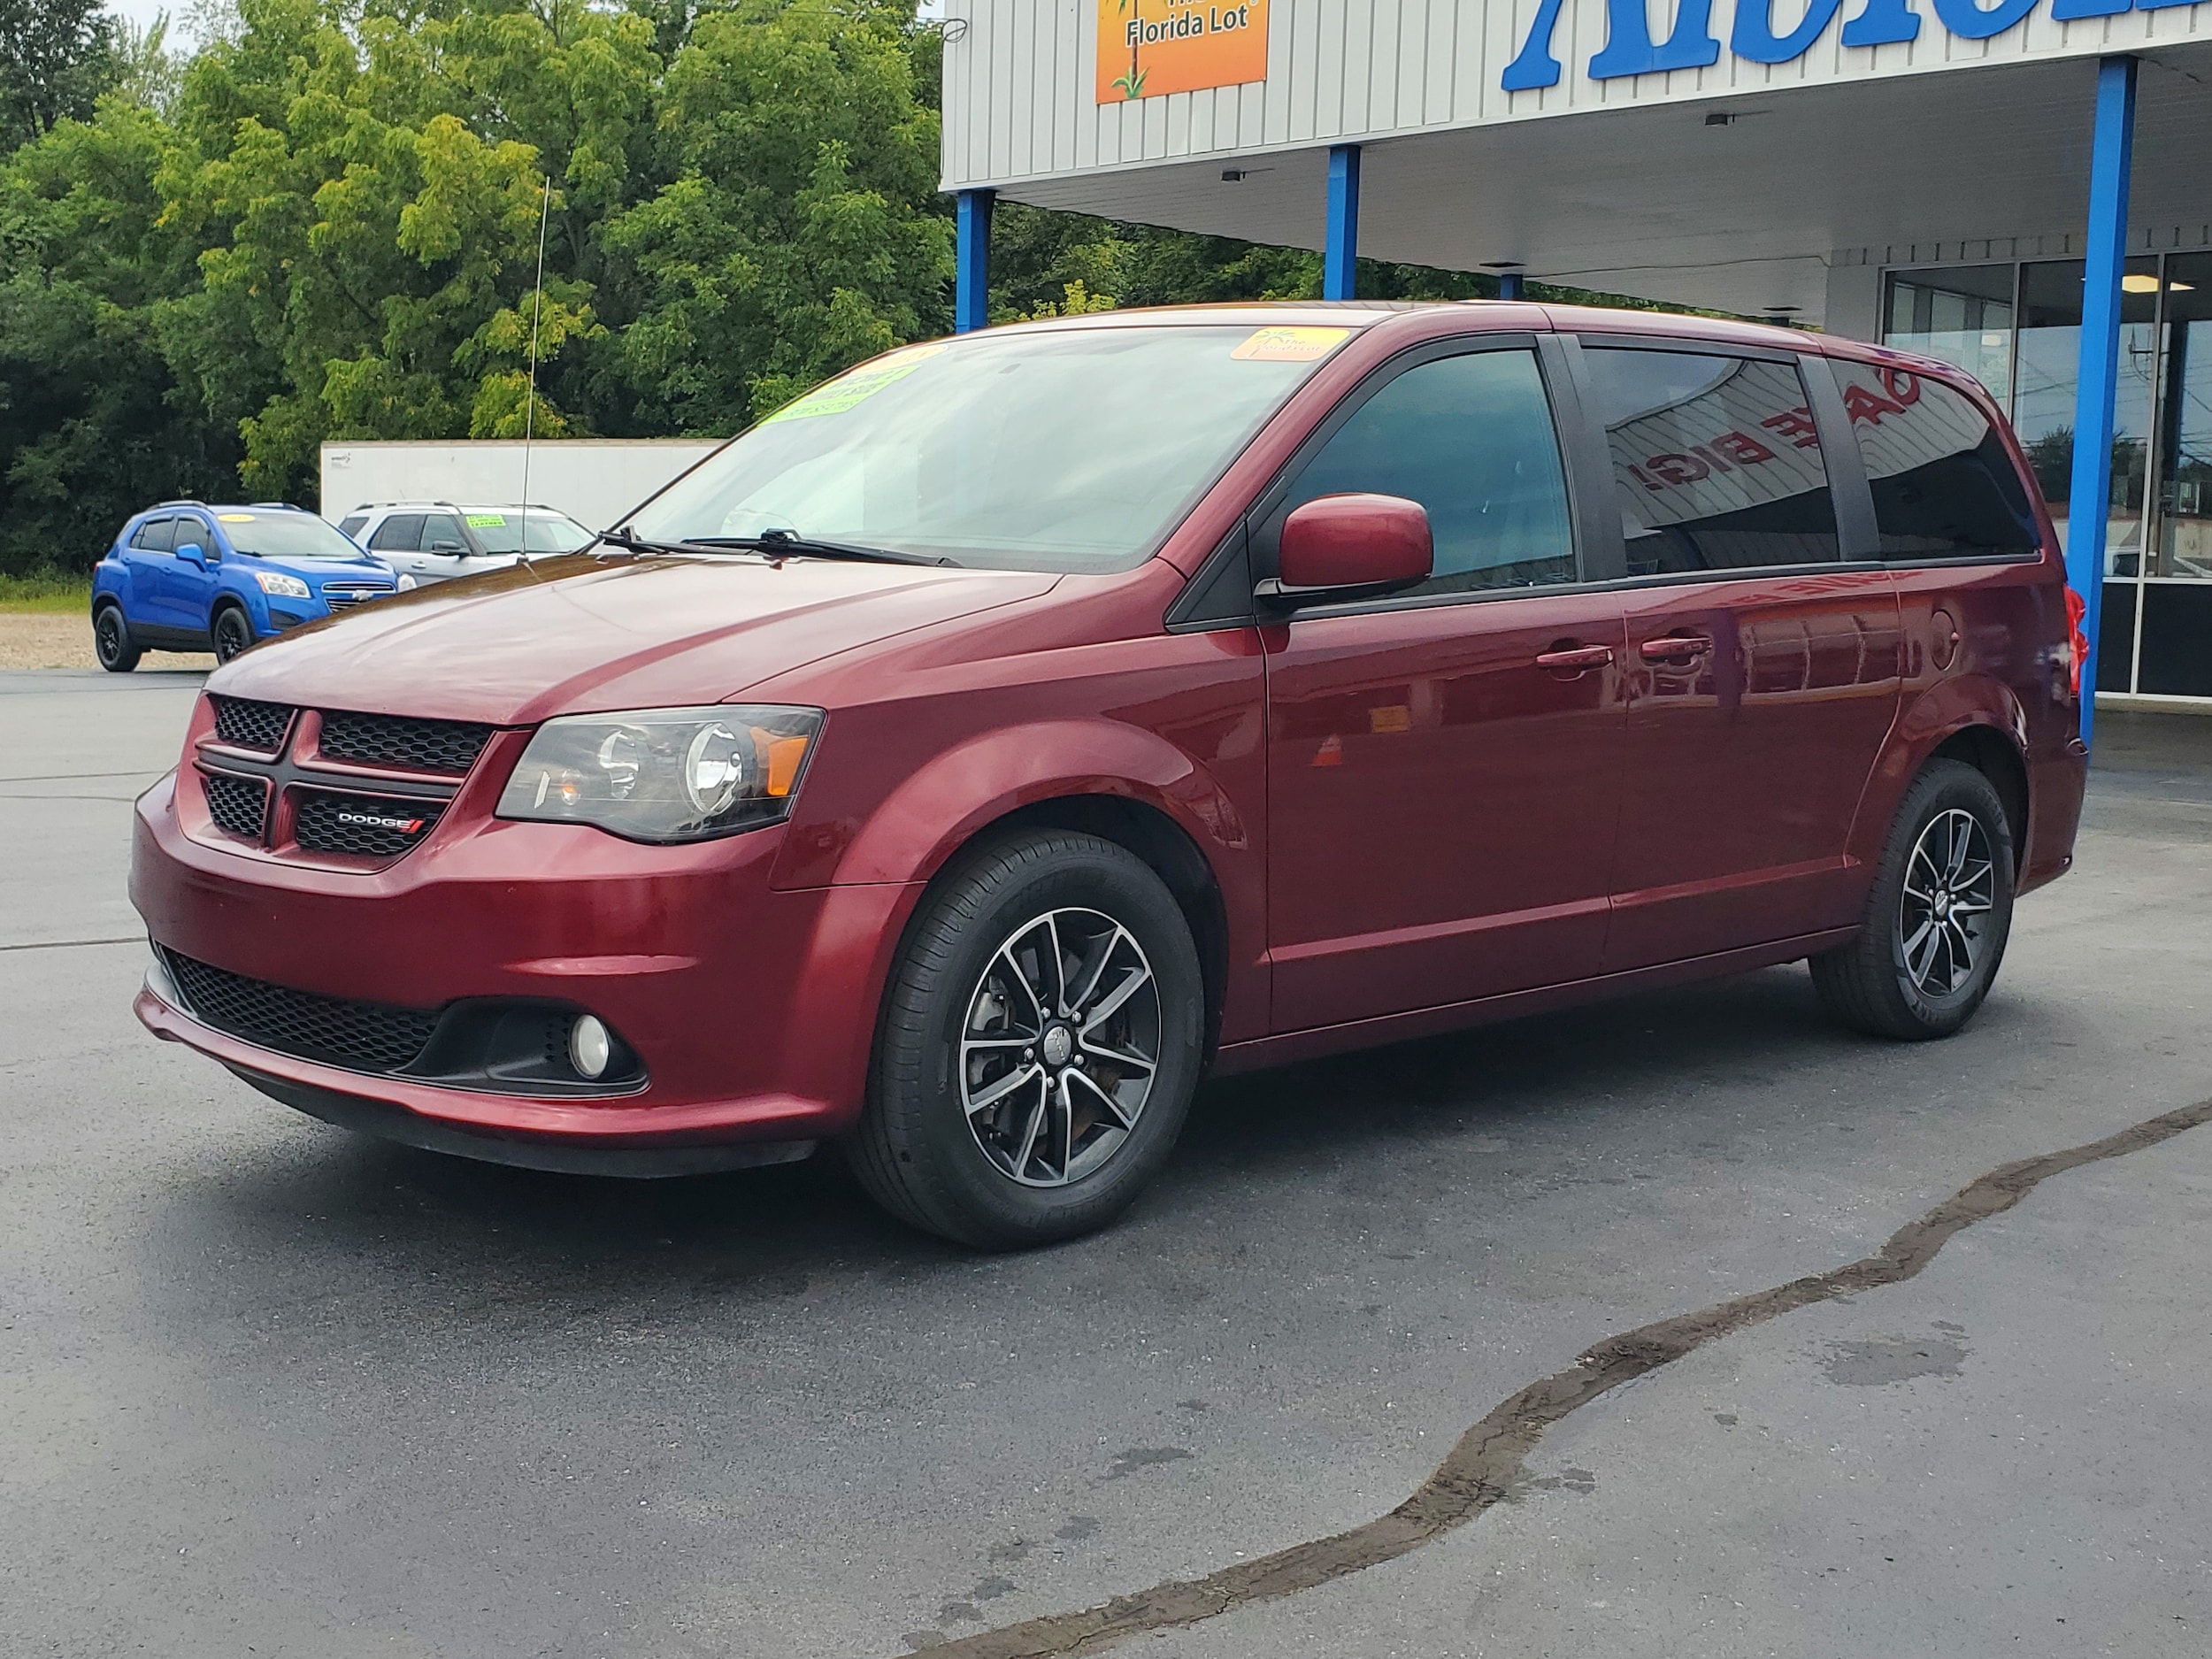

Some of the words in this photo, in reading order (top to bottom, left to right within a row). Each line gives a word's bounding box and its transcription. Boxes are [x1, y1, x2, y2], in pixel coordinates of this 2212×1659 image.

[1126, 11, 1203, 46] Florida
[1210, 4, 1248, 32] Lot
[338, 812, 411, 829] DODGE
